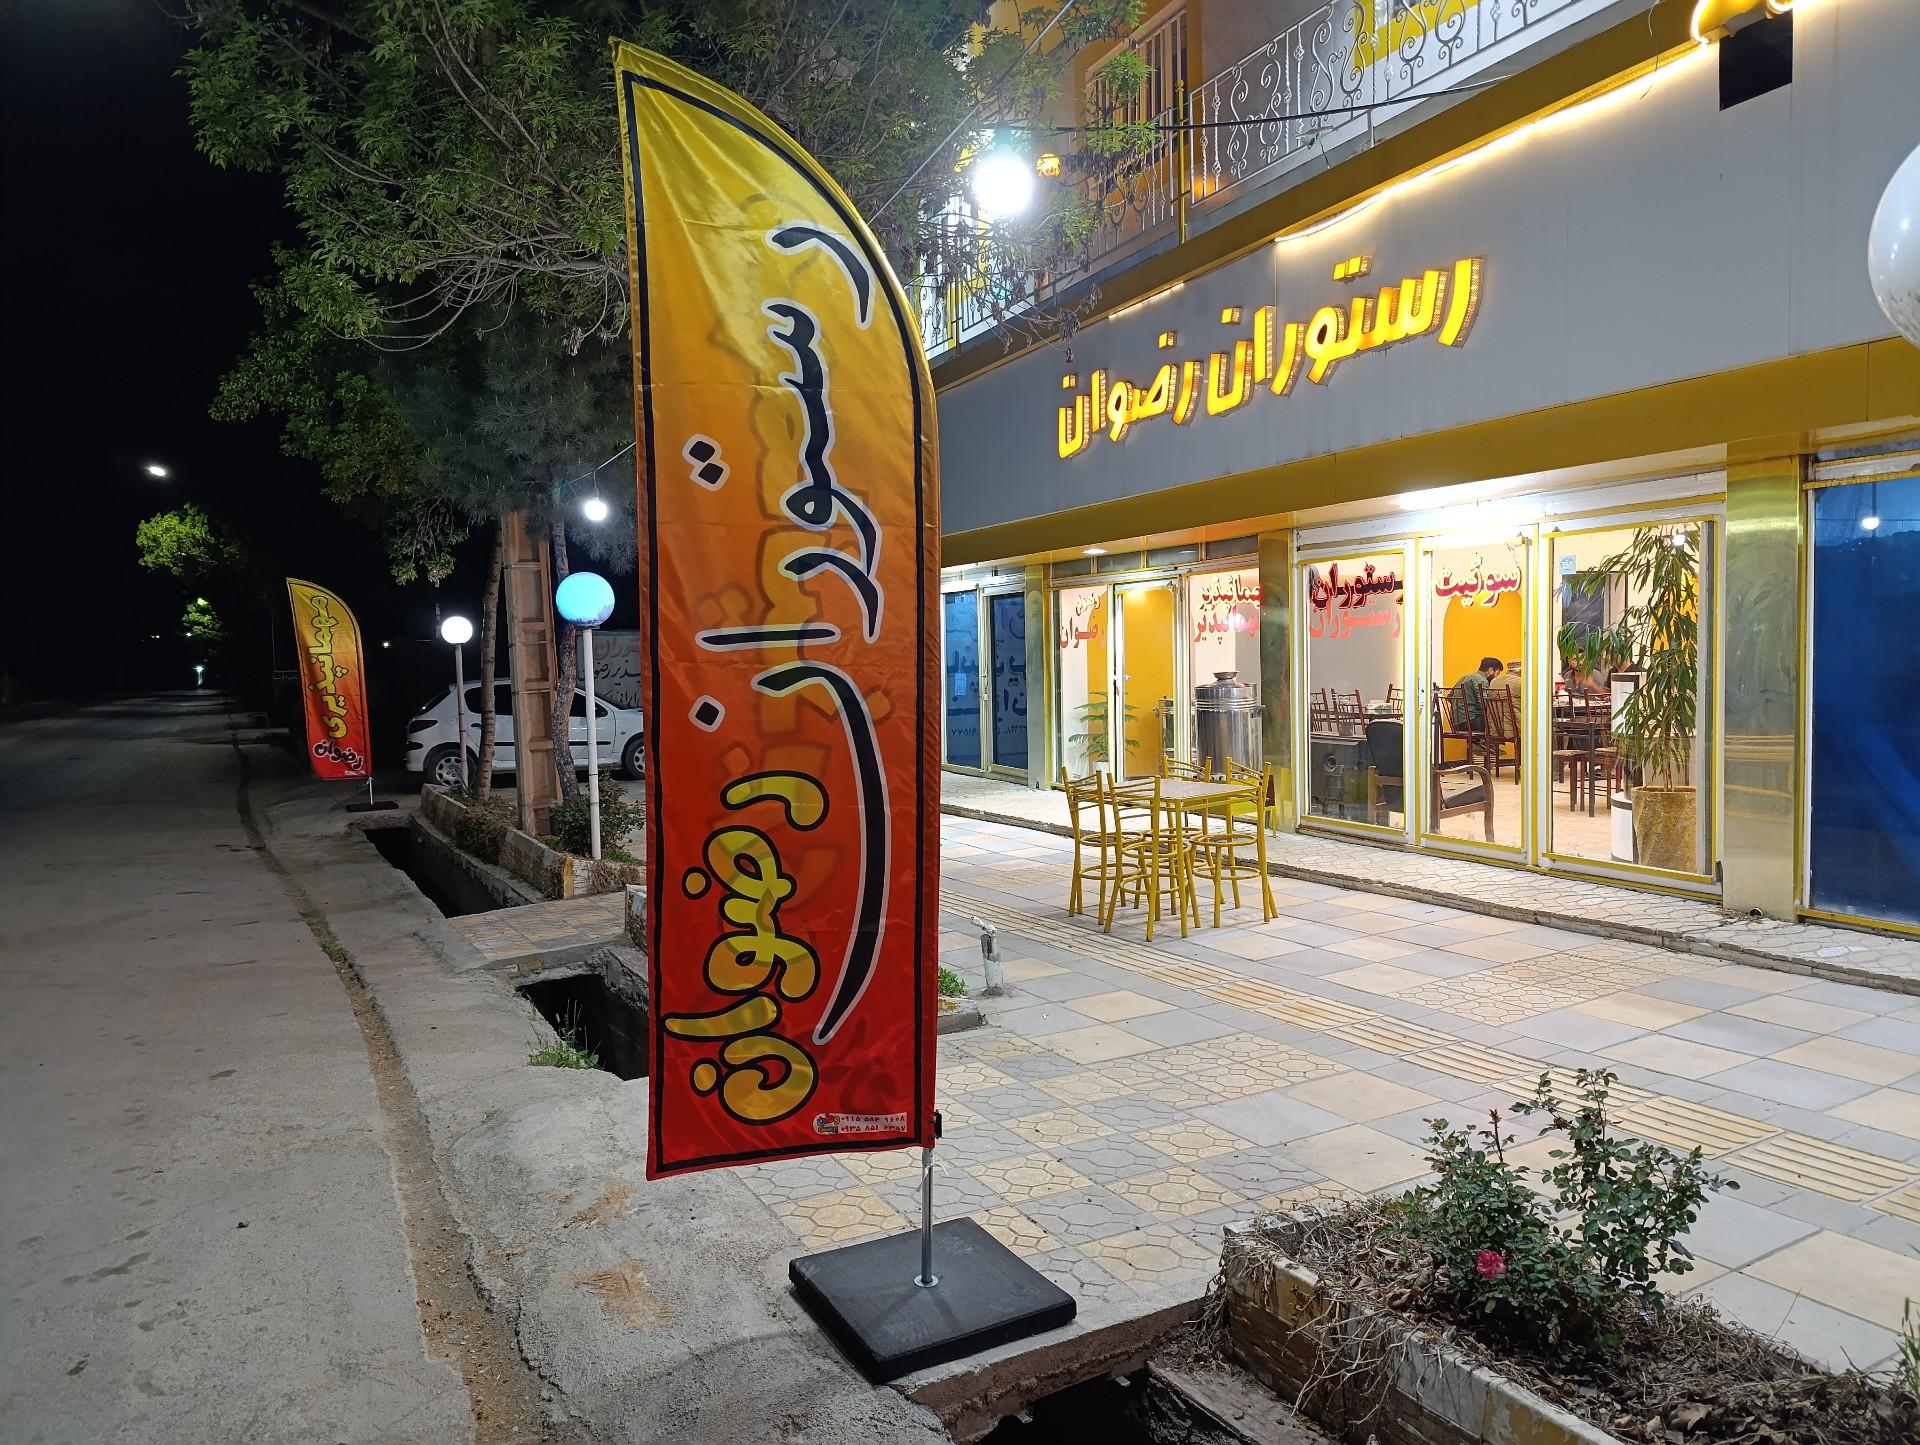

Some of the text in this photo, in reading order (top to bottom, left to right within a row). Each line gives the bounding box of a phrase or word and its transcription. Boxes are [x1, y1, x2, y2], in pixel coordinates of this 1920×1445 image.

[1058, 255, 1485, 459] رستوران رضوان
[312, 739, 363, 770] رضوان
[682, 221, 888, 1047] رستوران
[662, 770, 829, 1122] رضوان
